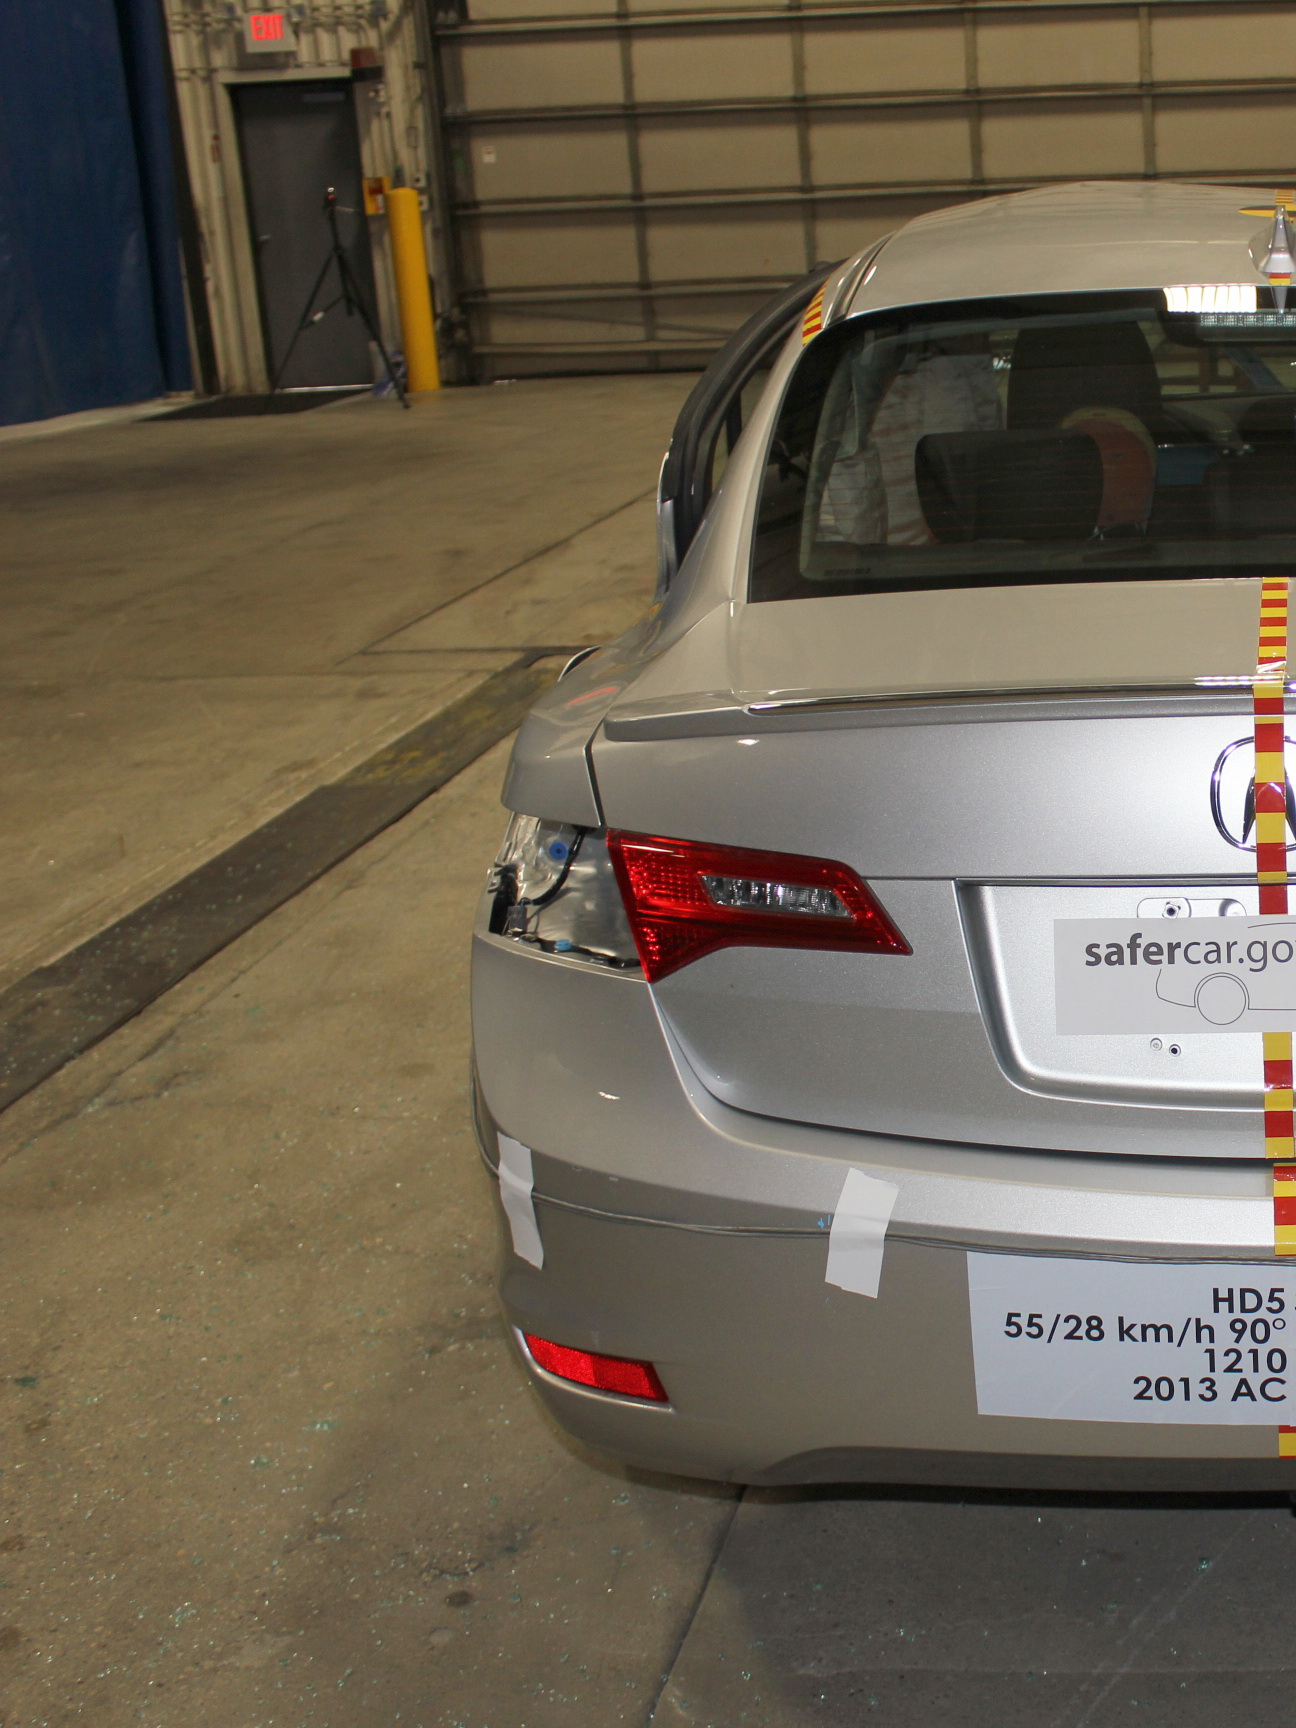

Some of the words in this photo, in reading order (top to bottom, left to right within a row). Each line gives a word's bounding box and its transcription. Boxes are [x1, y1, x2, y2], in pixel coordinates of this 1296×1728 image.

[250, 14, 284, 40] EXIT
[1003, 1312, 1105, 1344] 55/28
[1117, 1315, 1215, 1347] km/h
[1229, 1317, 1286, 1344] 90°
[1133, 1375, 1218, 1402] 2013
